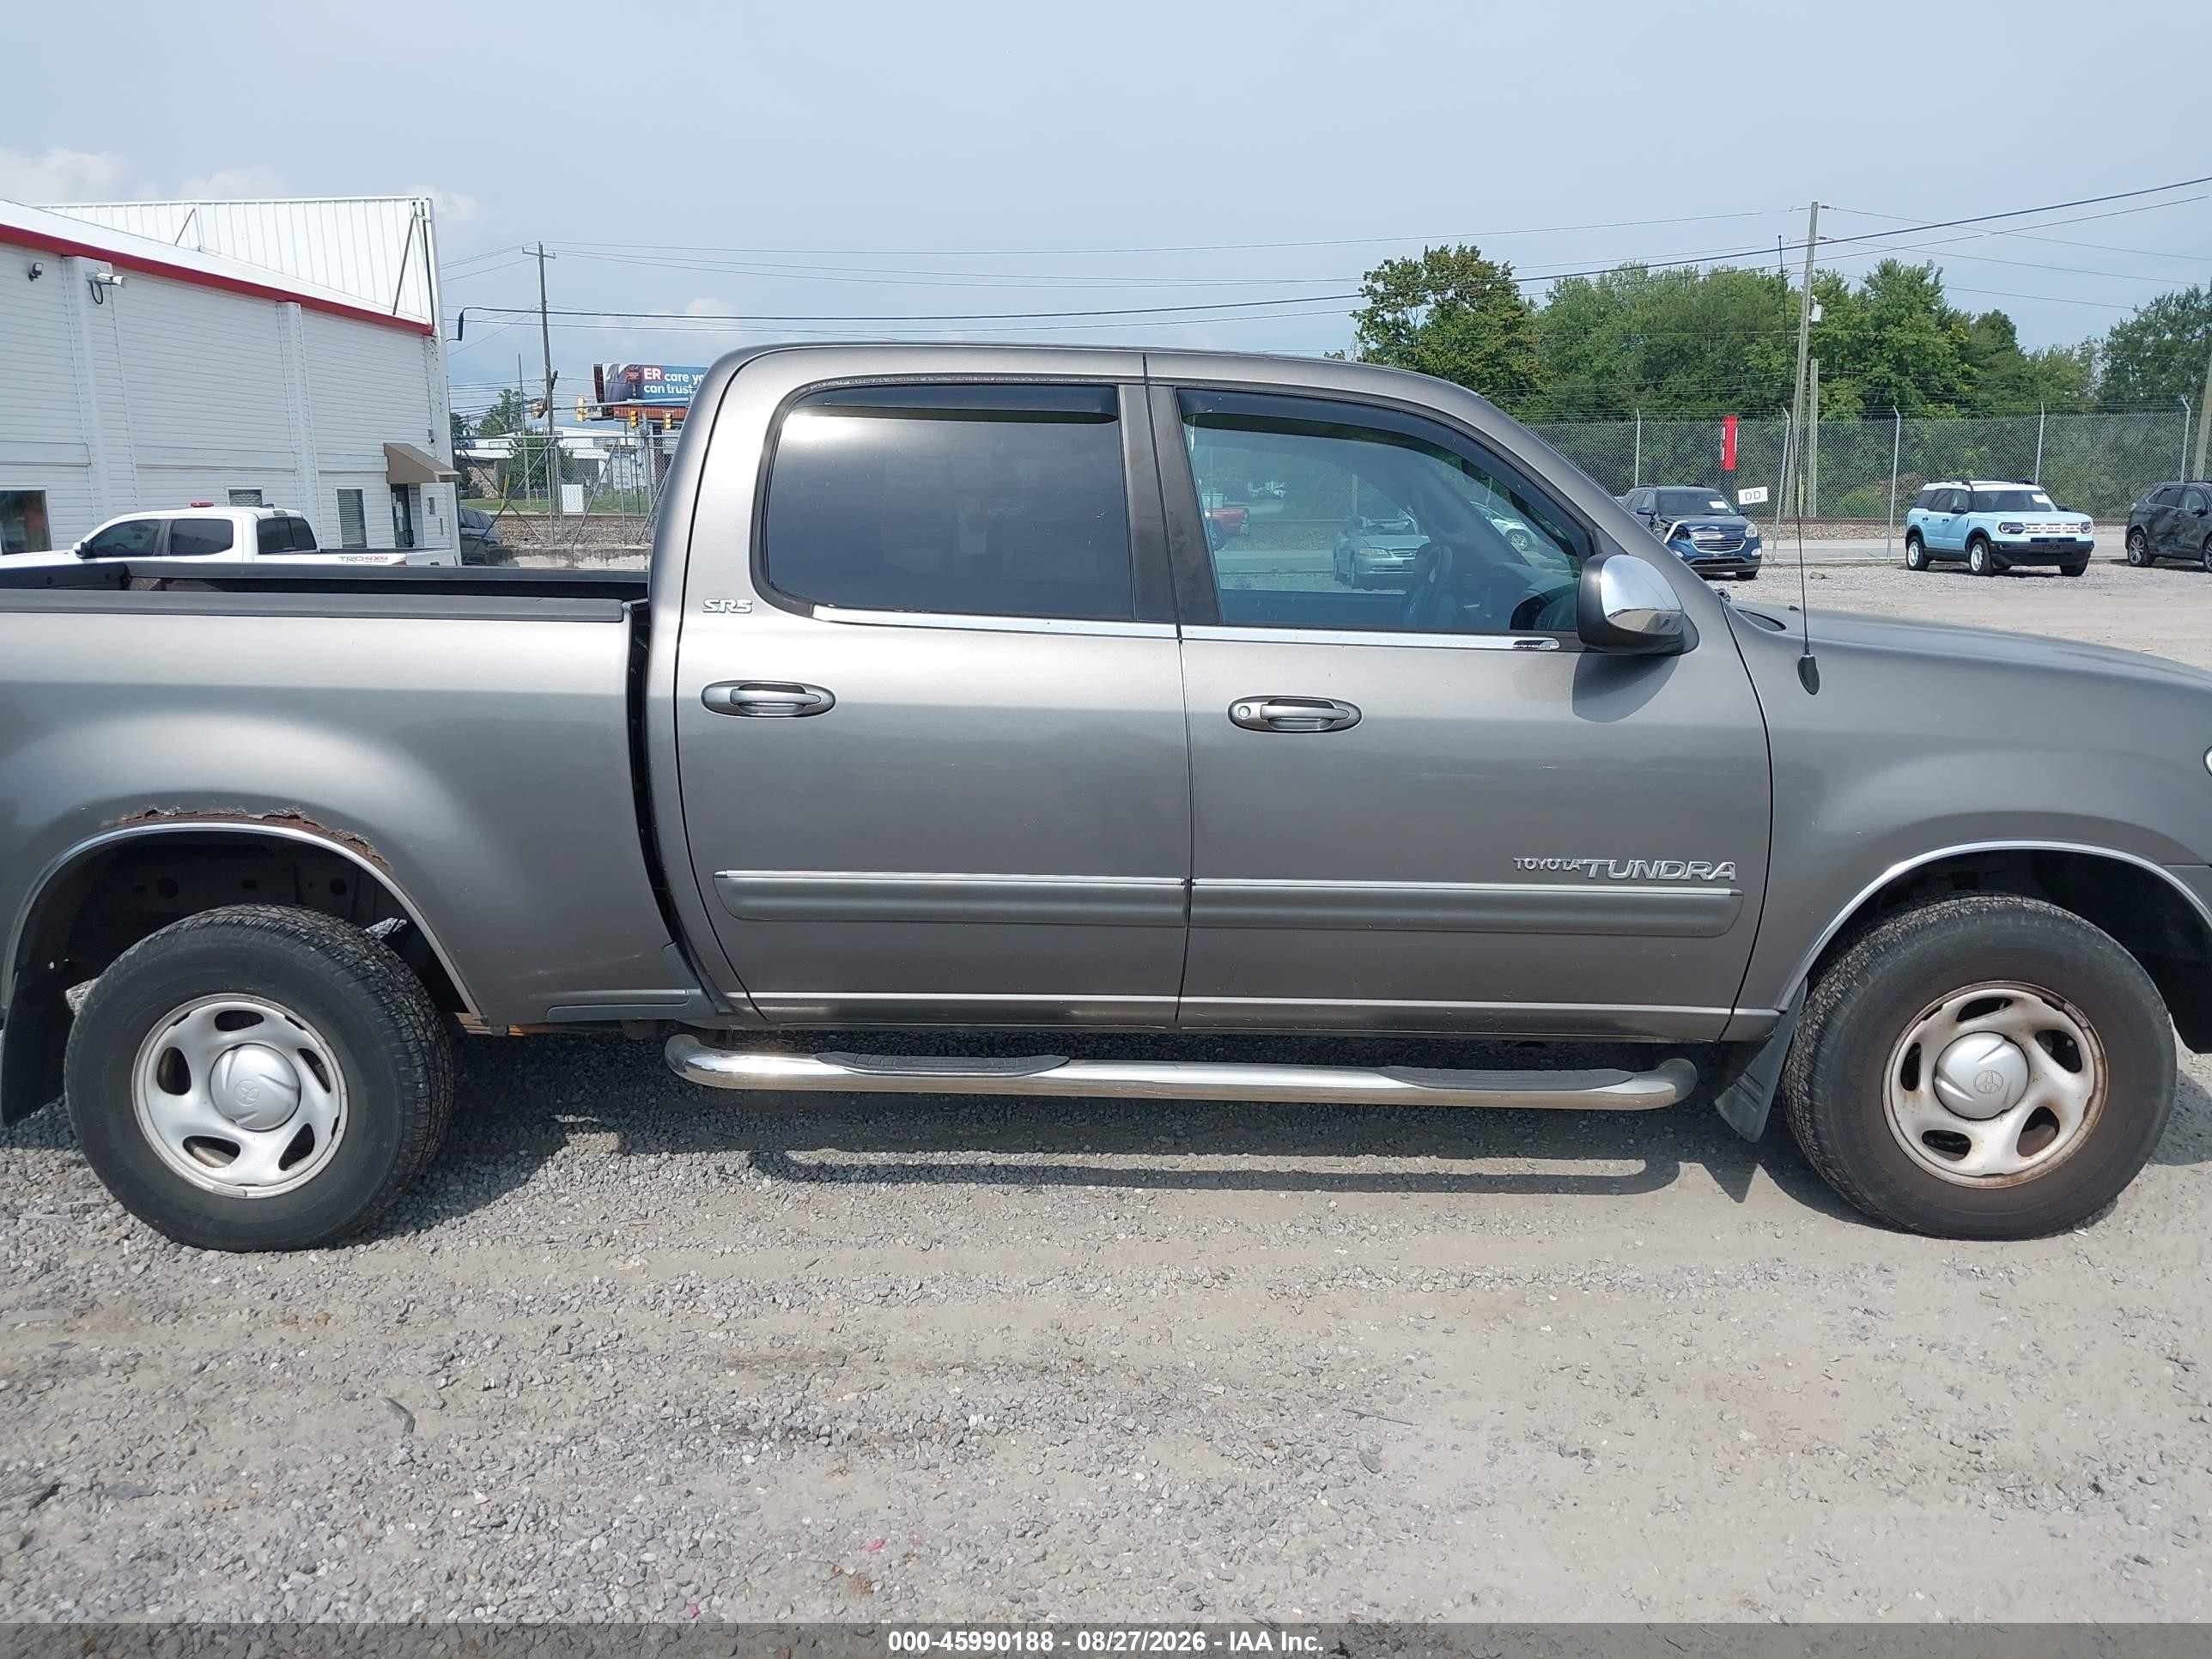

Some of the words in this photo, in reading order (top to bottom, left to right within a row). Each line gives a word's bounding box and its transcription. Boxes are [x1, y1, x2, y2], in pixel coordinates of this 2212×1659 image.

[643, 368, 662, 380] ER
[664, 373, 690, 382] care
[692, 374, 704, 385] yo
[643, 385, 665, 393] can
[666, 383, 696, 394] trust.
[702, 599, 753, 614] SR5
[1513, 858, 1581, 872] TOYOTA
[1582, 859, 1736, 880] TUNDRA
